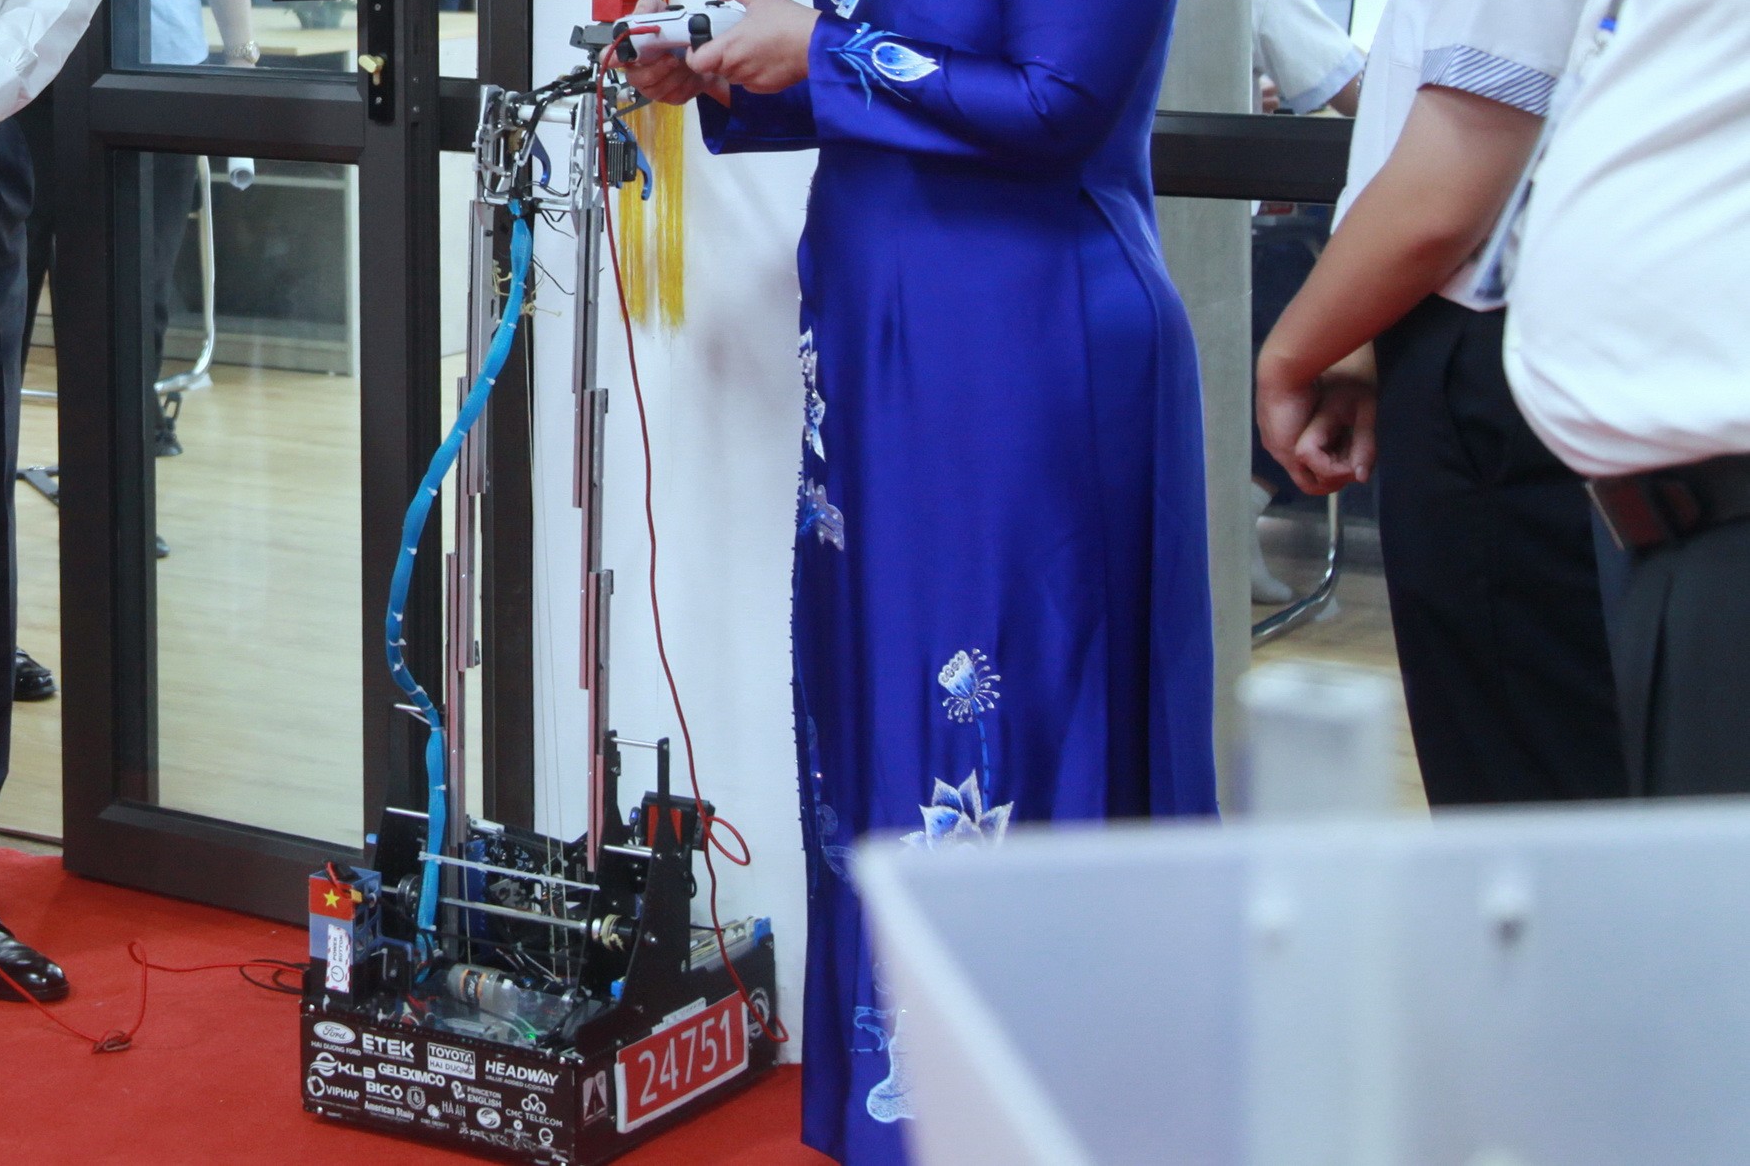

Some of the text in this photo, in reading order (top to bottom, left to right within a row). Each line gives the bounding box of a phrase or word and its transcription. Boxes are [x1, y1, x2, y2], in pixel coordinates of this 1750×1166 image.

[362, 1033, 415, 1058] ETEK
[429, 1046, 474, 1064] TOYOTA
[638, 1009, 732, 1107] 24751
[378, 1062, 446, 1087] GELEXIMCO
[484, 1059, 559, 1086] HEADWAY
[467, 1094, 502, 1109] ENGLISH
[505, 1108, 564, 1128] CMC TELECOM
